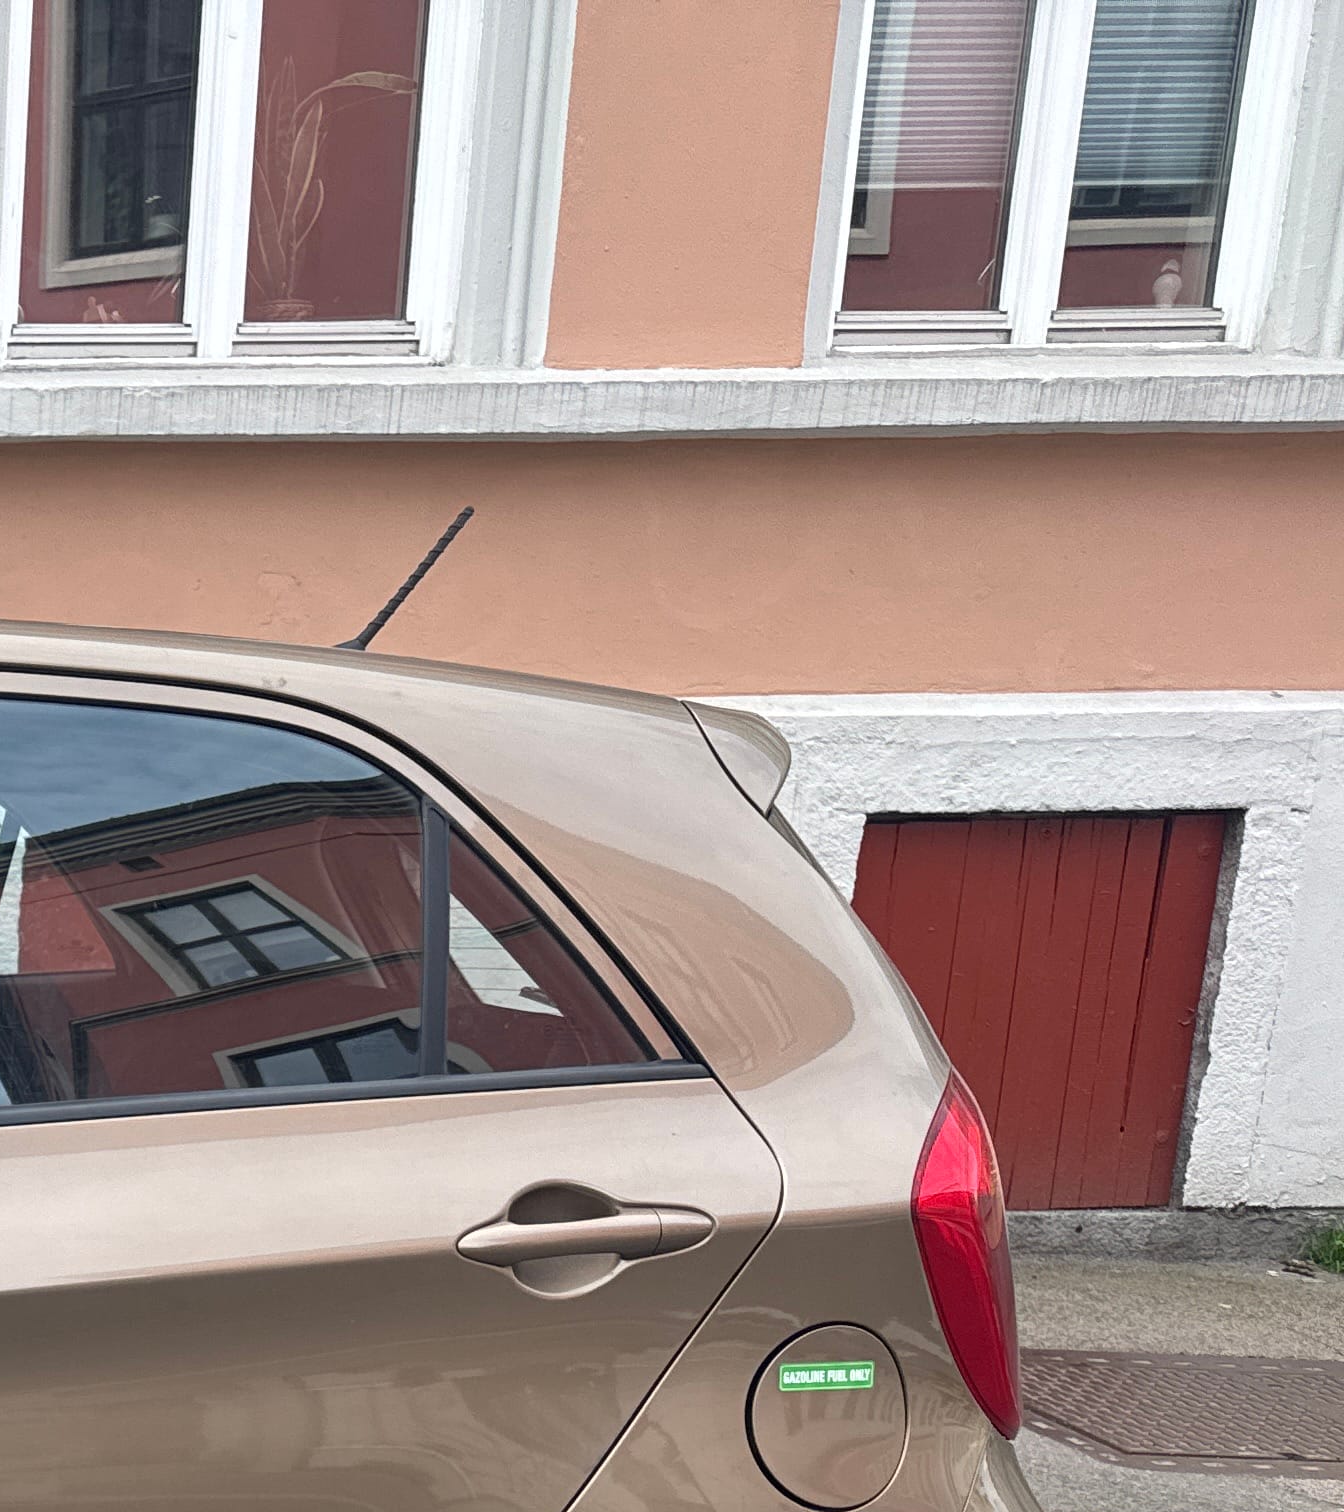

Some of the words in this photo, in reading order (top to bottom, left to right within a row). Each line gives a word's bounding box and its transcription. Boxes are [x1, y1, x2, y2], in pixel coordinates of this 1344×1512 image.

[783, 1370, 825, 1385] GAZOLINE
[827, 1369, 847, 1383] FUEL
[850, 1368, 871, 1383] ONLY
